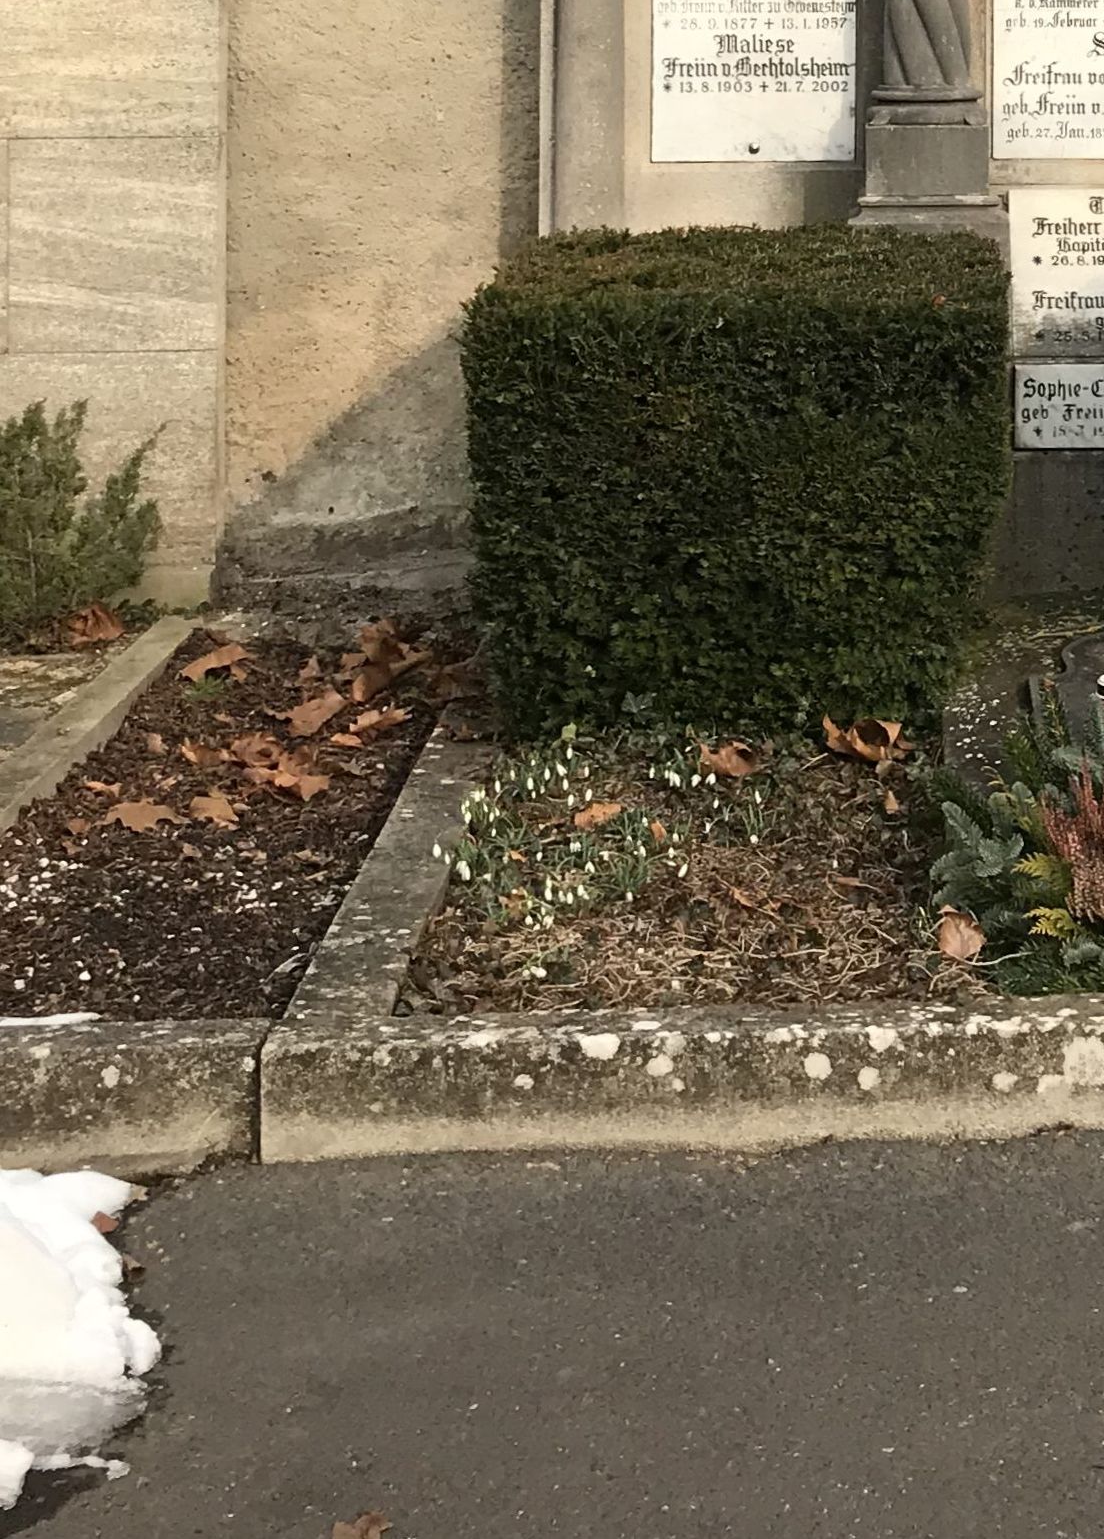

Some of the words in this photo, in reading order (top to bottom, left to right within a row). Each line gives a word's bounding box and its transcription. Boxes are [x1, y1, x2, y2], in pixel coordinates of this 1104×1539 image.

[817, 17, 848, 30] 1957
[1049, 11, 1098, 31] Februar
[713, 34, 796, 57] Maliese
[662, 58, 719, 82] Freiin
[1002, 60, 1083, 92] Freifrau
[719, 81, 753, 93] 1903
[813, 81, 849, 93] 2002
[1034, 90, 1087, 118] Freiin
[1031, 217, 1102, 238] Freiherr
